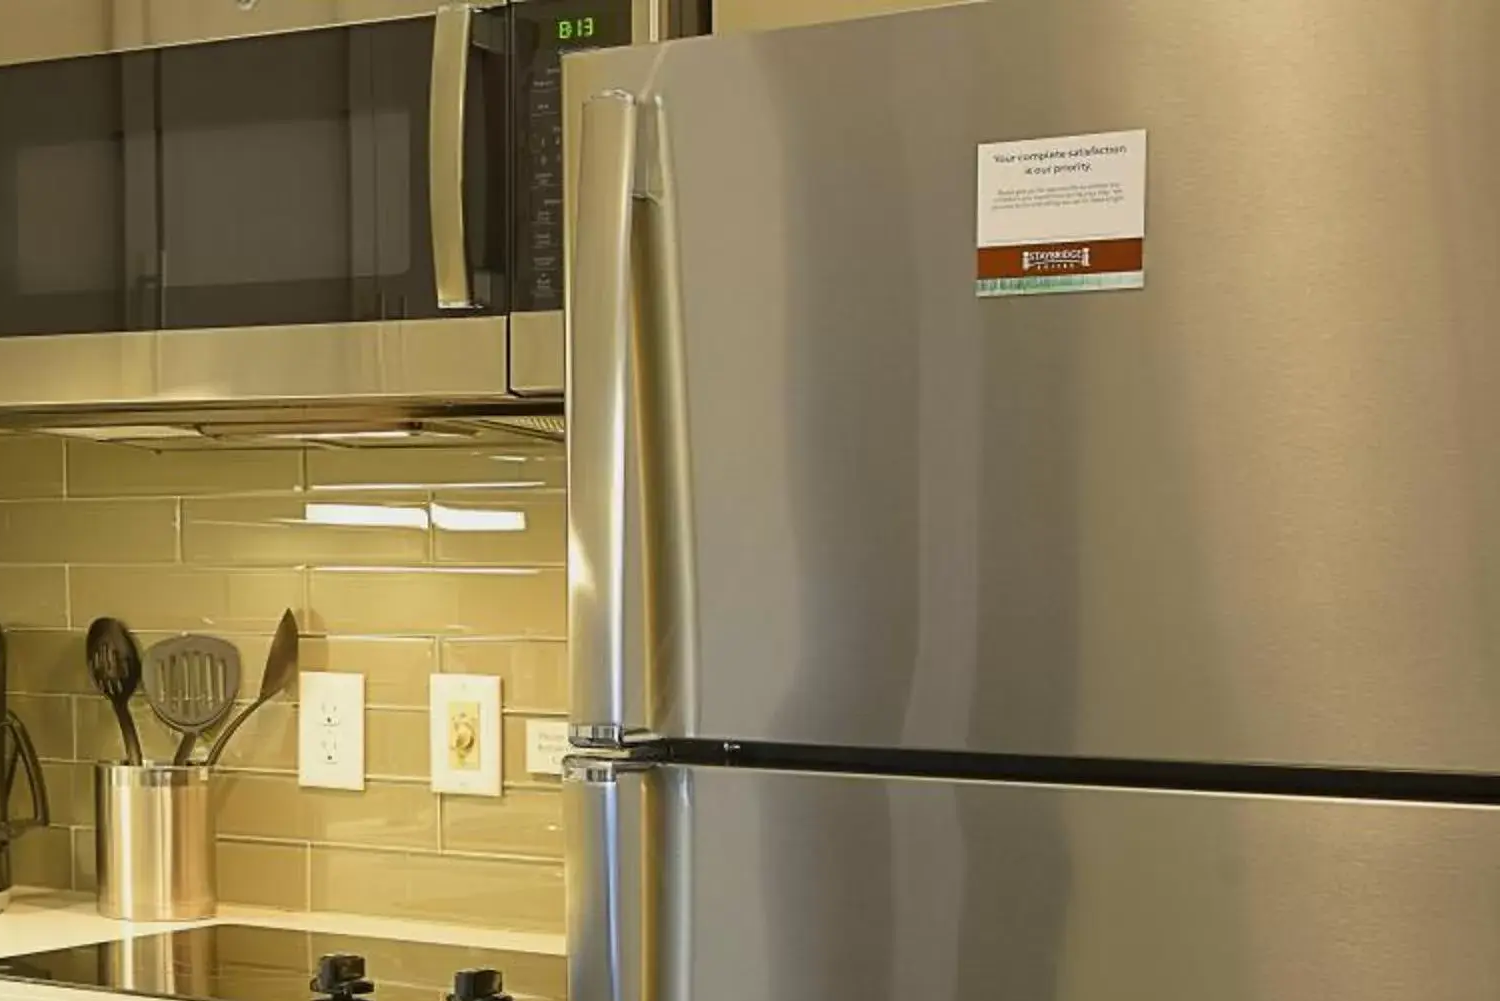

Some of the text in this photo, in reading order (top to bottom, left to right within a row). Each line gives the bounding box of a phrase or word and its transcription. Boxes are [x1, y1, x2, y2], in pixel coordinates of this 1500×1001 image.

[1018, 149, 1066, 162] complete
[1068, 144, 1128, 158] satisfaction
[1034, 166, 1052, 175] our
